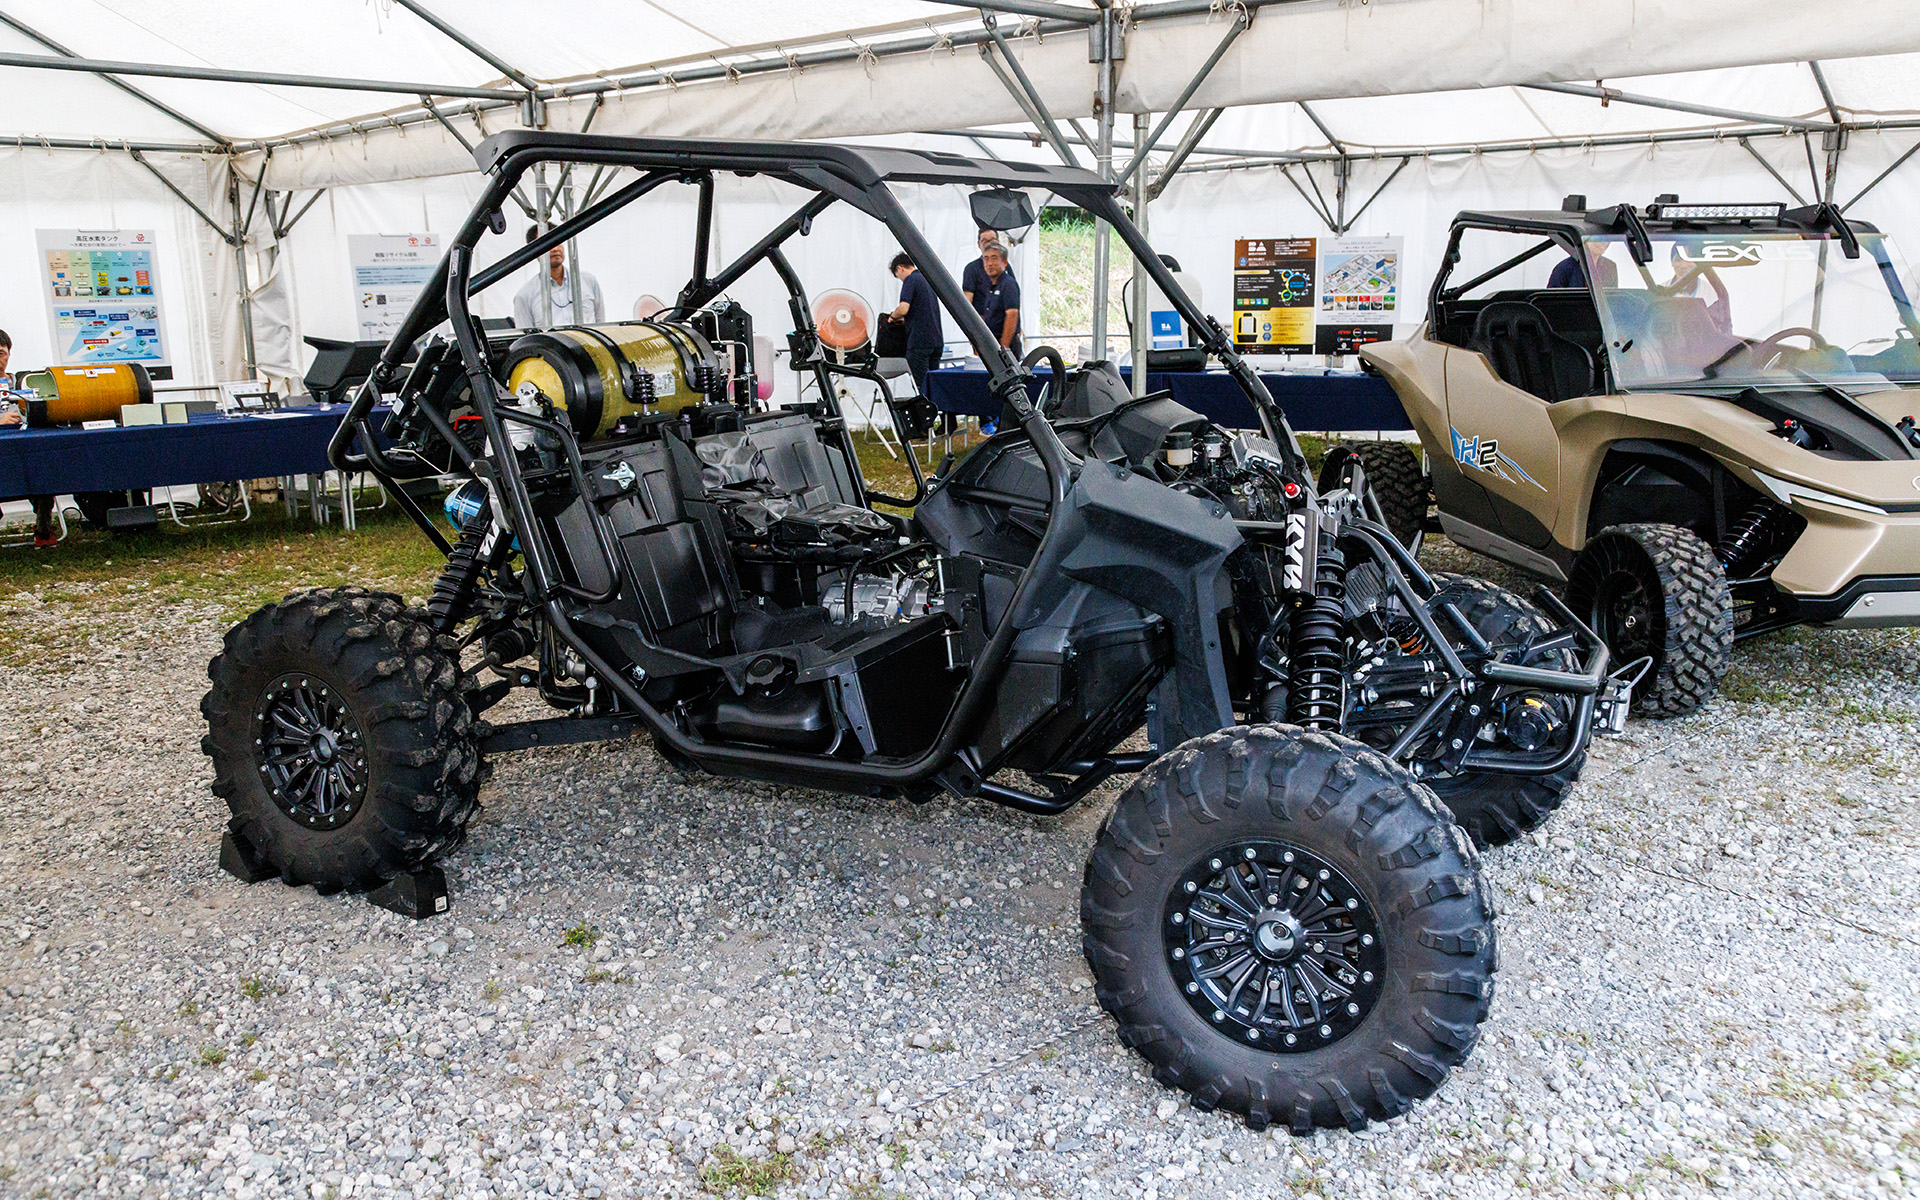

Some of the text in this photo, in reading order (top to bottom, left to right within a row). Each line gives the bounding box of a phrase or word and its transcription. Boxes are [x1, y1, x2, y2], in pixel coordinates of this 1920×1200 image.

[1675, 244, 1816, 262] LEXUS
[1459, 435, 1499, 467] H2
[1283, 514, 1306, 590] KYB
